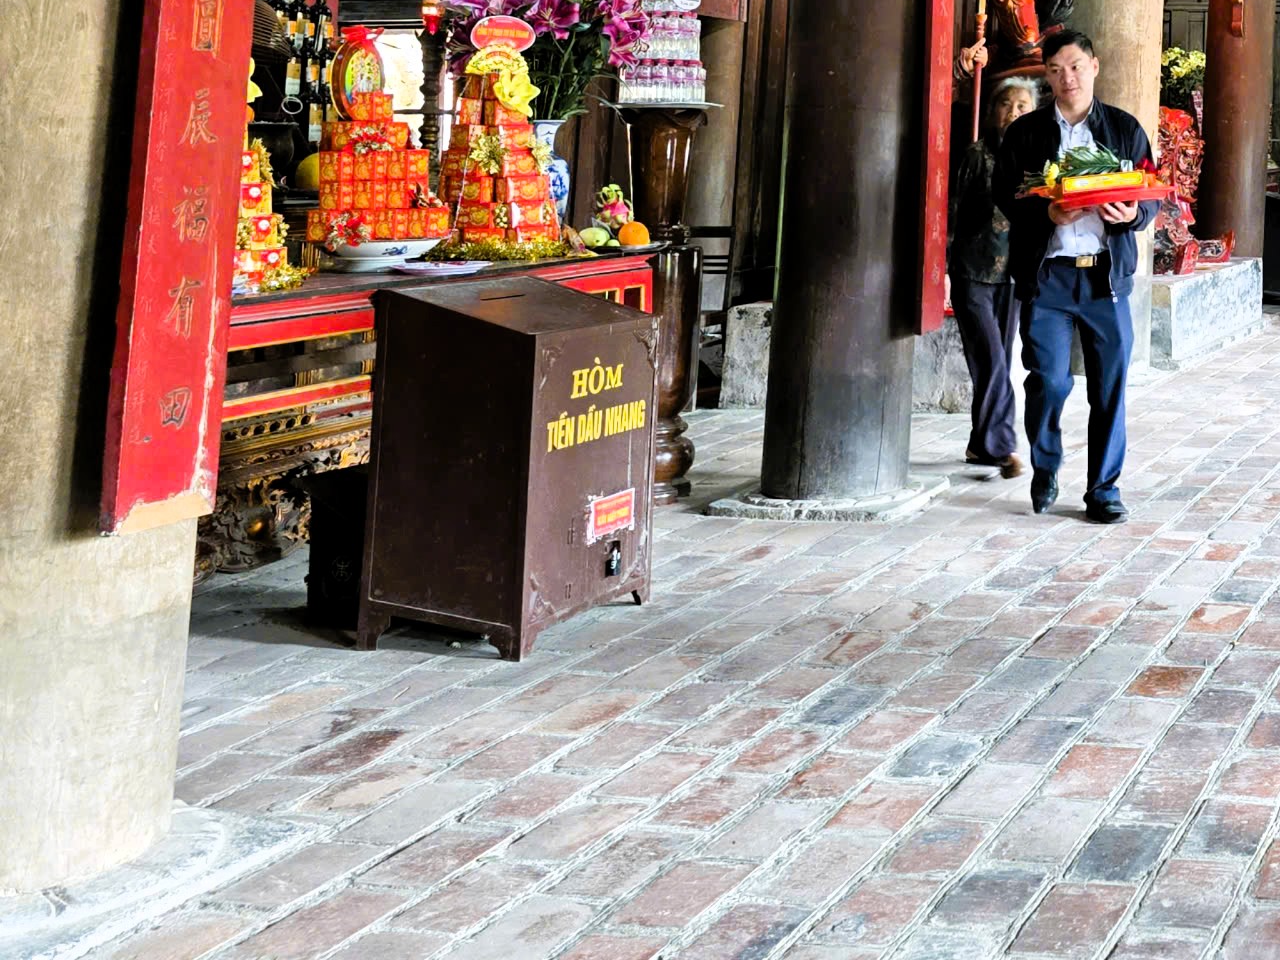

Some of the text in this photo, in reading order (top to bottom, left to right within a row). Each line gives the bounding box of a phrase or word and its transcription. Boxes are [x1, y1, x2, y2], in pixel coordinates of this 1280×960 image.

[571, 357, 624, 399] HÒM
[547, 400, 646, 452] TIỀN DẦU NHANG
